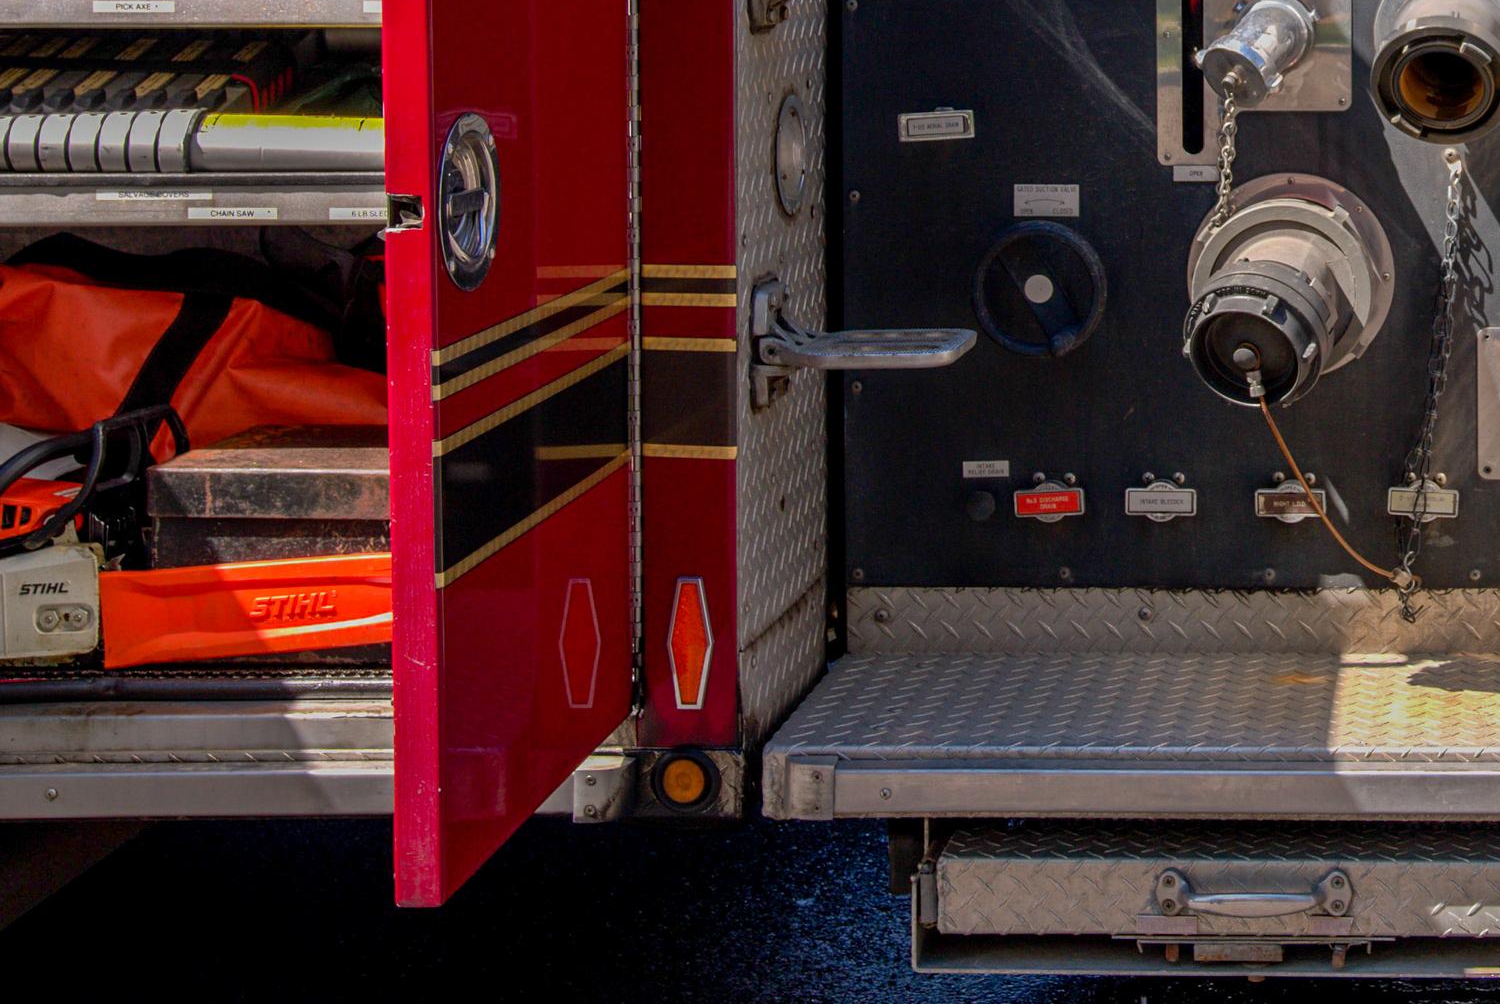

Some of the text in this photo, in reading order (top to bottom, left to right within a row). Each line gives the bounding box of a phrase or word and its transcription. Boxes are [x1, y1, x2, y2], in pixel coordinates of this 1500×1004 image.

[115, 3, 151, 11] PICK AXE
[18, 582, 69, 596] STIHL
[249, 591, 337, 622] STIHL
